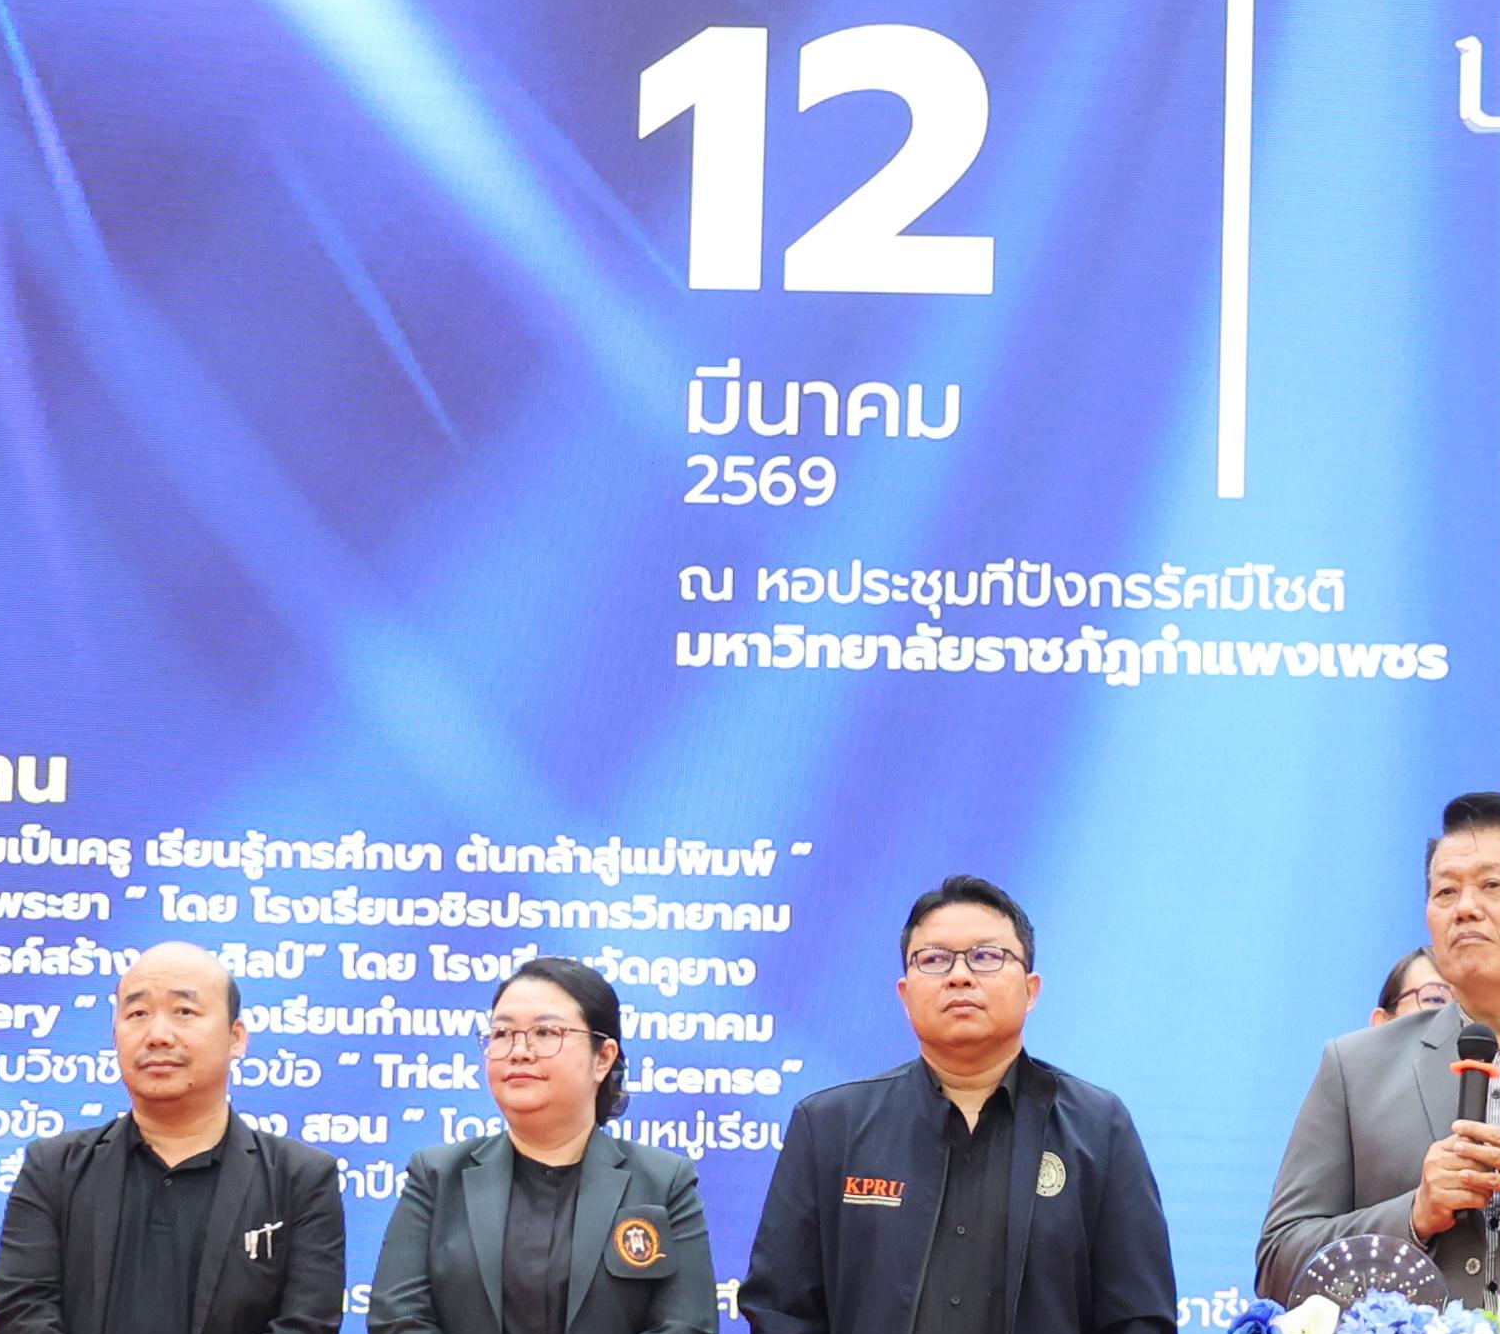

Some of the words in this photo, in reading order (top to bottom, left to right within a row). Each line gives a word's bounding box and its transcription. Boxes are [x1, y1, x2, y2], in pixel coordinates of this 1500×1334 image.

[637, 23, 996, 296] 12
[686, 357, 961, 439] มีนาคม
[683, 453, 838, 507] 2569
[678, 564, 735, 603] ณ
[756, 558, 1346, 619] หอประชุมทีปังกรรัศมีโชติ
[145, 827, 443, 880] เรียนรู้การศึกษา
[455, 833, 778, 887] ต้นกล้าสู่แม่พิมพ์
[157, 884, 239, 924] โดย
[250, 881, 792, 933] โรงเรียนวชิรปราการวิทยาคม
[337, 943, 417, 982] โดย
[372, 1052, 481, 1091] Trick
[300, 1113, 389, 1144] สอน
[844, 1175, 907, 1199] KPRU
